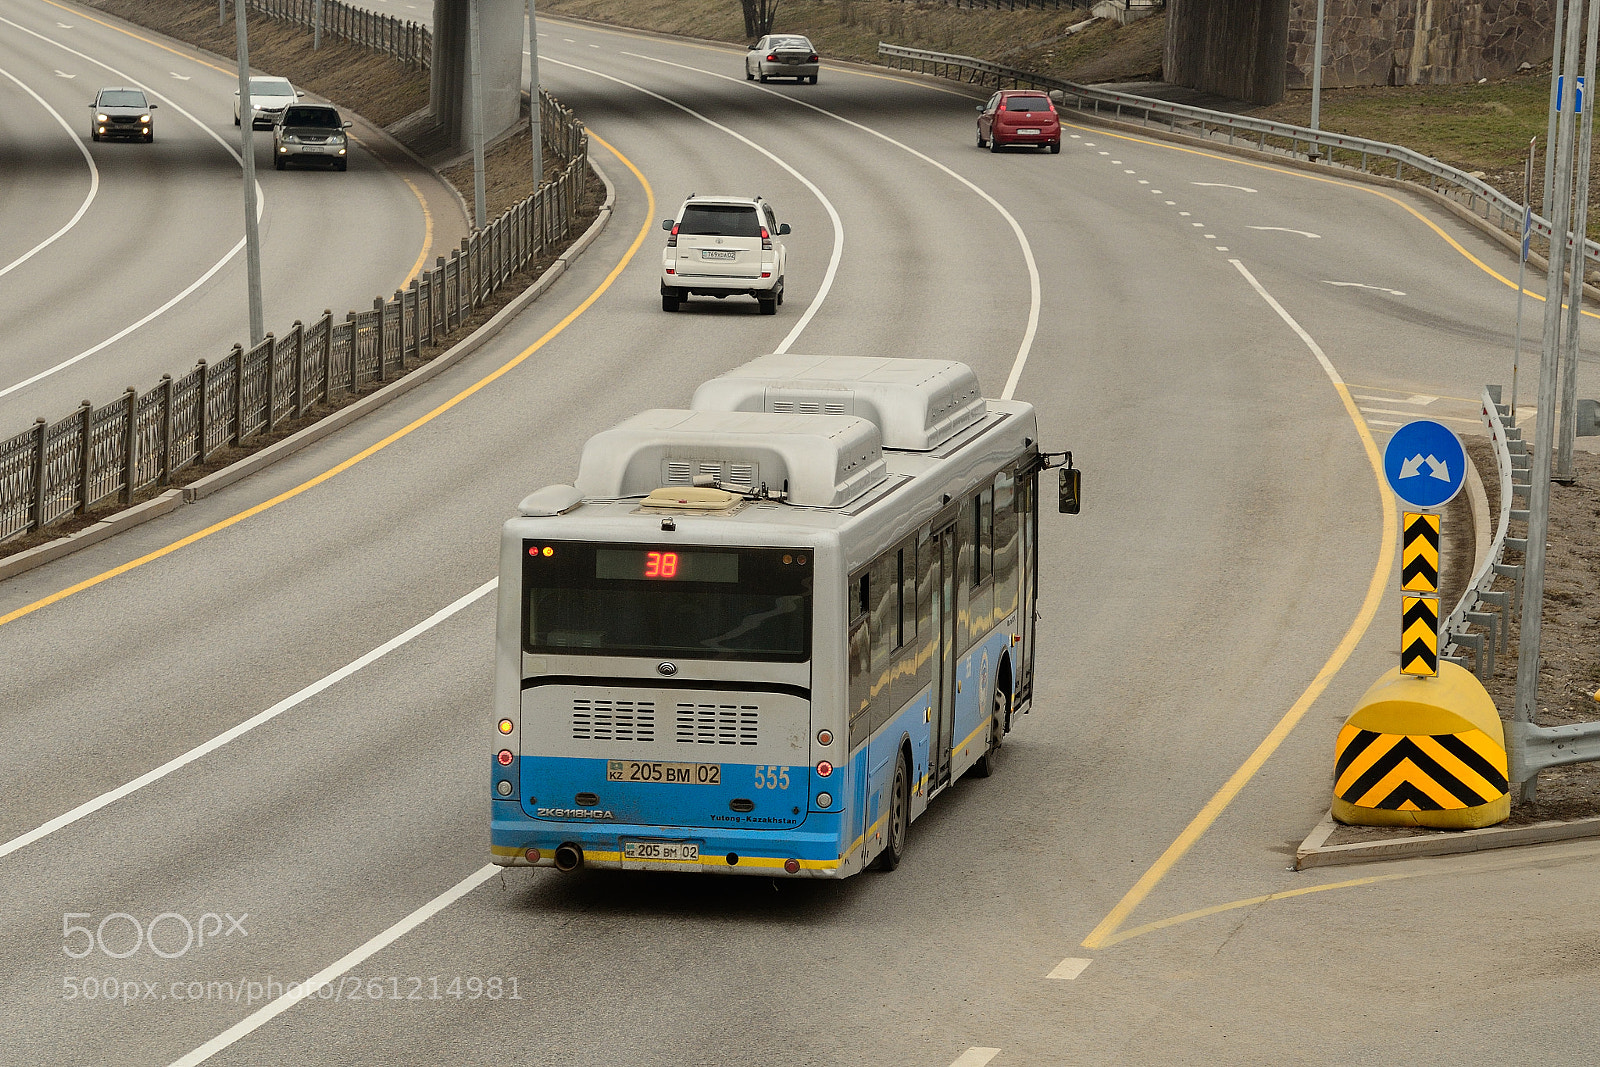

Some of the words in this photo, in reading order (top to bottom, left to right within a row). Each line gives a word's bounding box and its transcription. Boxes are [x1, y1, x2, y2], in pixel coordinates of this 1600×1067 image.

[646, 552, 677, 577] 38
[609, 772, 623, 780] KZ
[630, 763, 662, 781] 205
[666, 768, 690, 782] BM
[698, 766, 719, 783] 02
[754, 765, 790, 790] 555
[537, 808, 614, 819] ZK6118HGA
[710, 814, 797, 825] Yutong-Kazakhstan
[638, 844, 660, 857] 205
[664, 848, 677, 858] BM
[682, 846, 697, 858] 02
